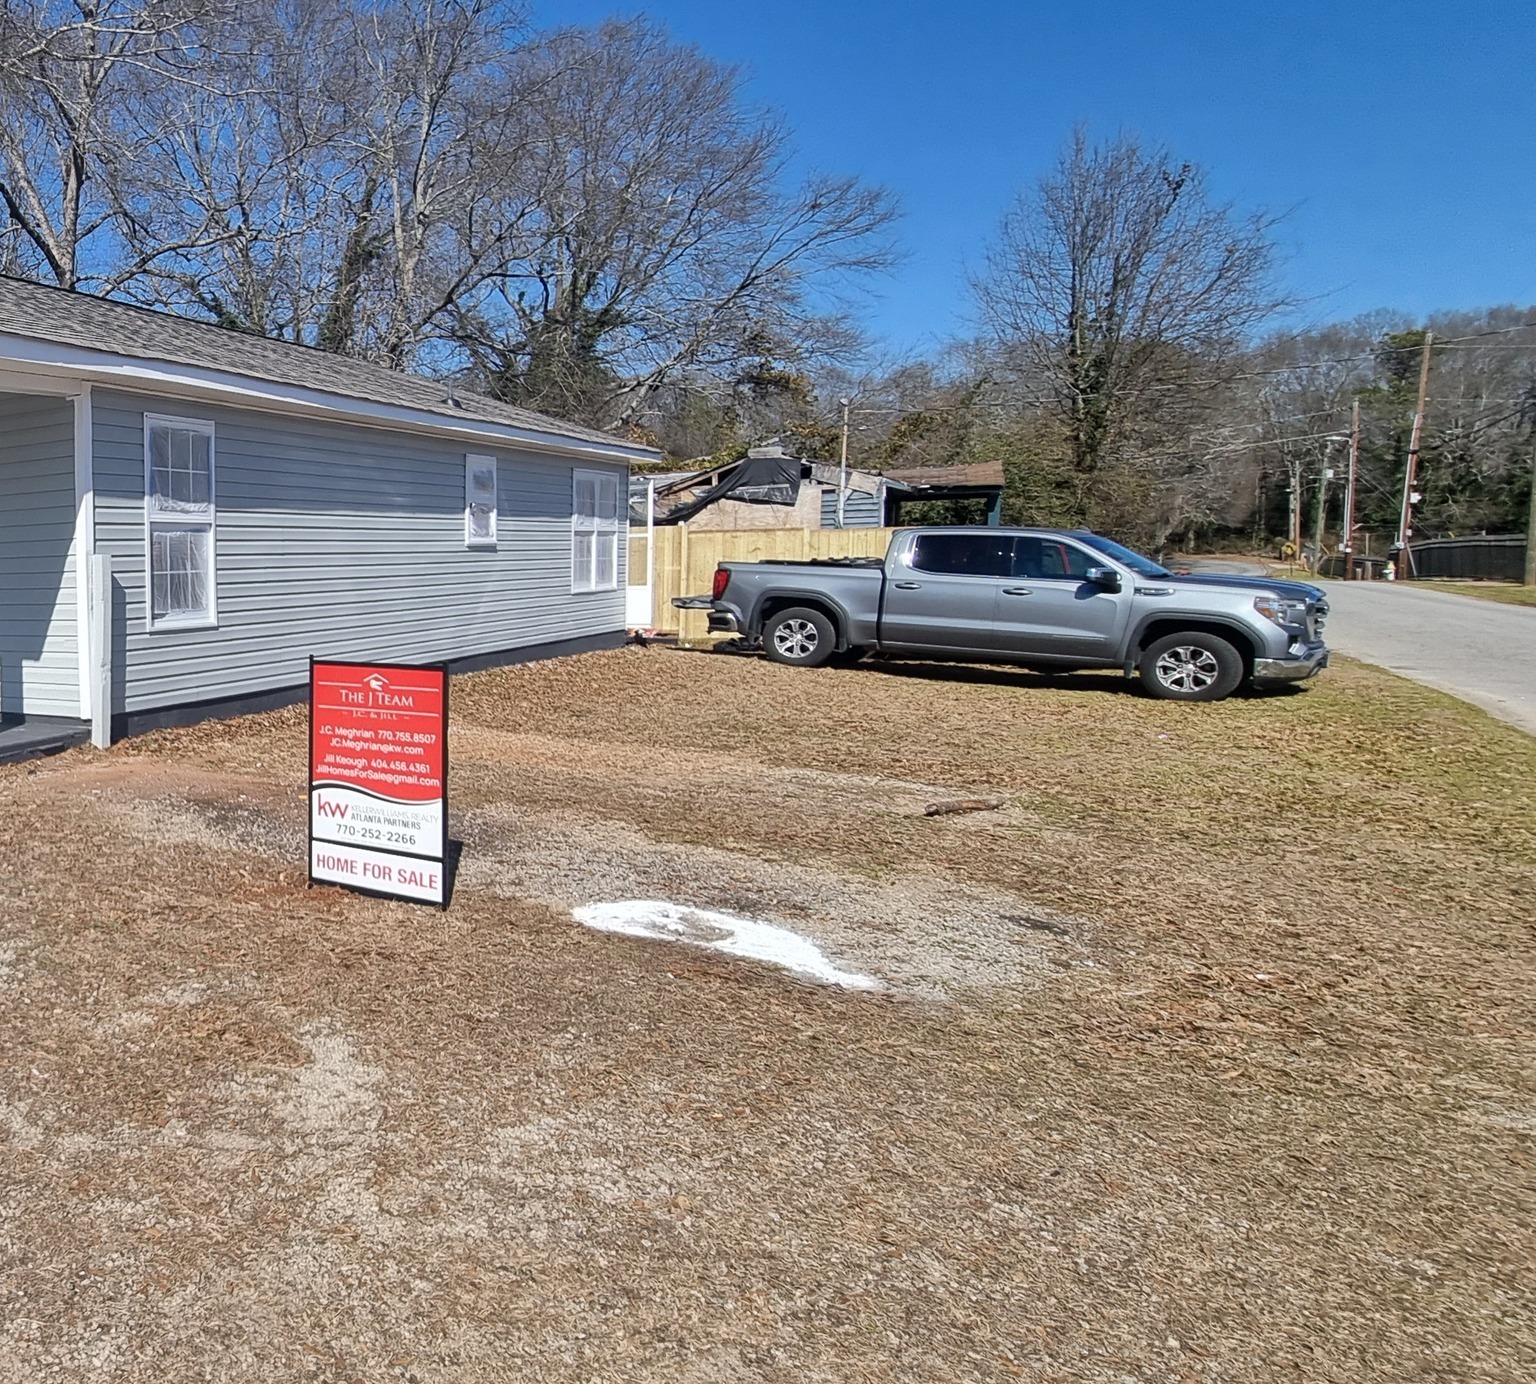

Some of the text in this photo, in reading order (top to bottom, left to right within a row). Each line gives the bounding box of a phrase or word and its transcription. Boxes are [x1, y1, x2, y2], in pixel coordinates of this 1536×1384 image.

[339, 689, 414, 707] THE J TEAM
[370, 711, 378, 719] &
[319, 725, 436, 744] J.C. Meghrian 770.755.8507
[330, 737, 424, 755] JC.Meghrian@kw.com
[324, 754, 430, 774] Jill Keough 404.456.4361
[316, 764, 440, 787] JillHomesForSale@gmail.com
[318, 793, 349, 819] kw
[351, 812, 421, 831] ATLANTA PARTNERS
[410, 810, 440, 824] REALTY
[336, 823, 416, 846] 770-252-2266
[316, 853, 438, 890] HOME FOR SALE
